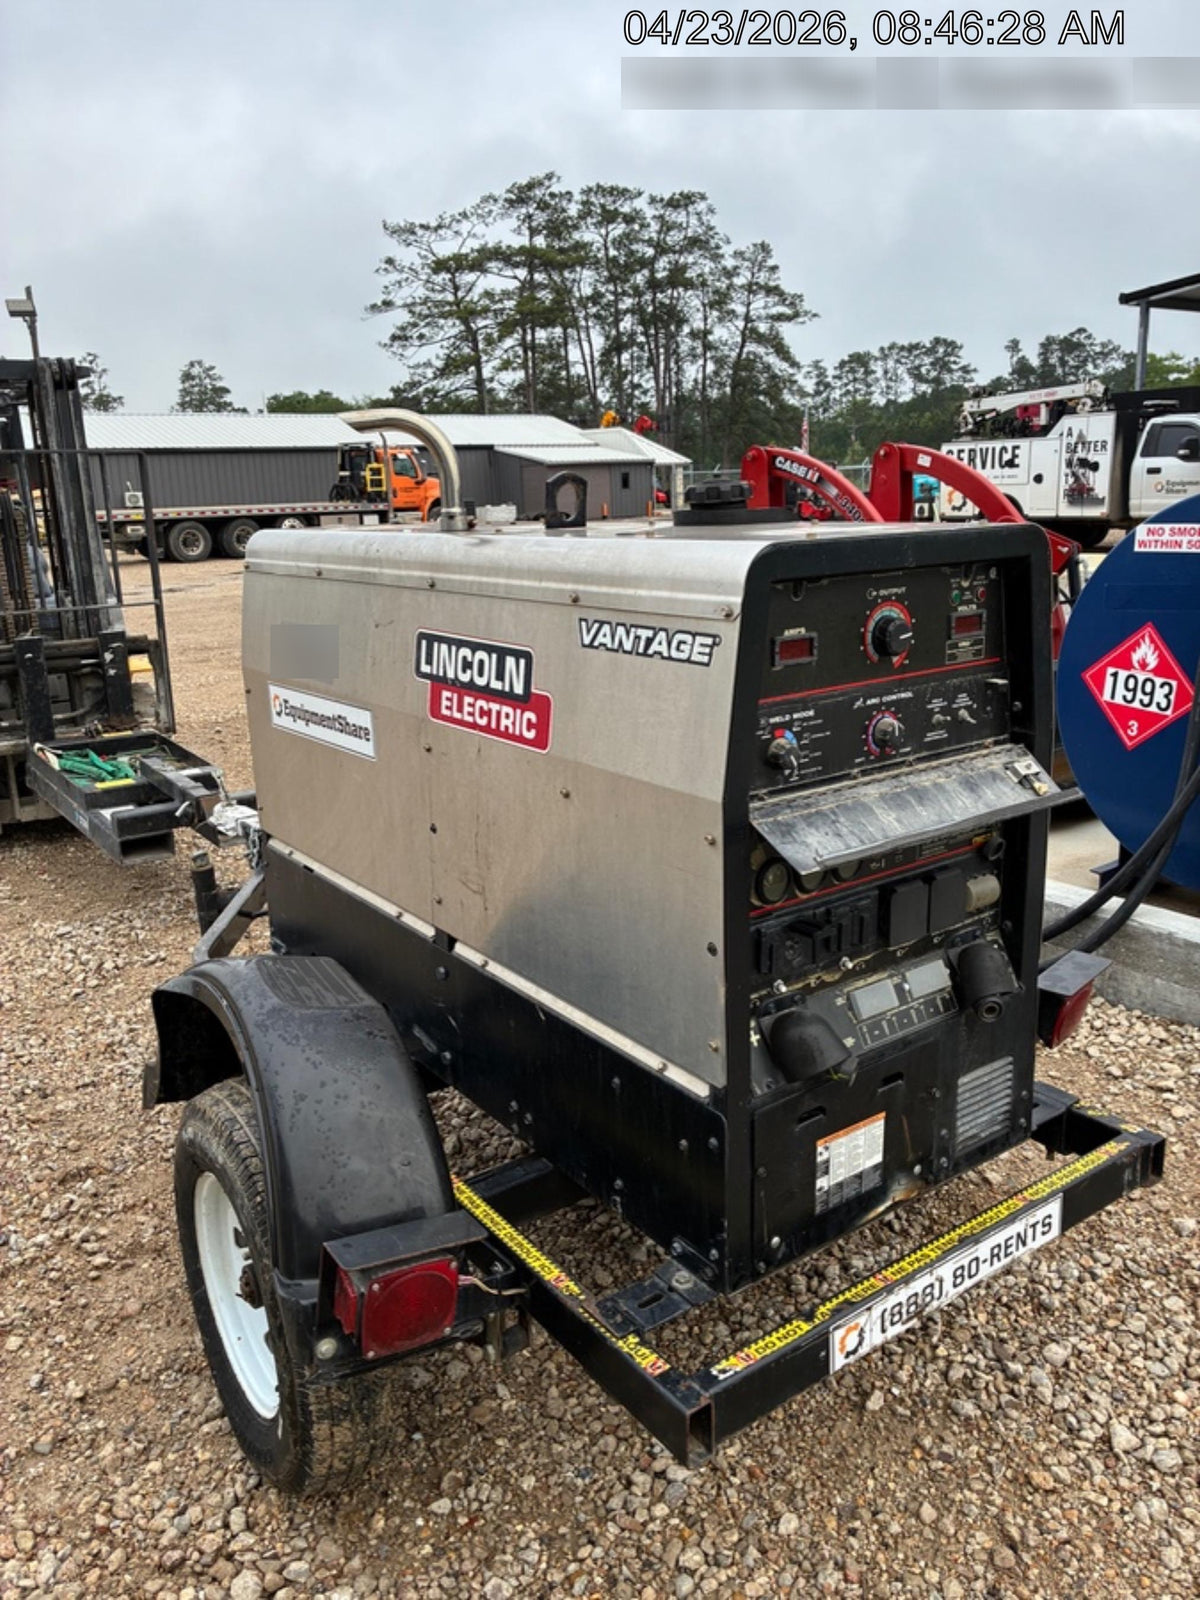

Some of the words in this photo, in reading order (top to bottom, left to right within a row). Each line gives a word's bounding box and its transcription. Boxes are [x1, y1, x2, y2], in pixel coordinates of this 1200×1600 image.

[1065, 440, 1109, 454] BETTER
[1066, 426, 1073, 438] A
[775, 456, 808, 480] CASE
[1137, 540, 1183, 550] WITHIN
[1146, 527, 1166, 537] NO
[1168, 527, 1200, 537] SMO
[579, 617, 715, 667] VANTAGE
[419, 638, 527, 695] LINCOLN
[1109, 670, 1174, 712] 1993
[282, 697, 372, 743] EquipmentShare
[440, 690, 538, 741] ELECTRIC
[1127, 720, 1139, 737] 3
[879, 1275, 945, 1334] (888)
[952, 1213, 1053, 1288] 80-RENTS
[752, 1337, 776, 1355] DO
[773, 1323, 804, 1344] NOT
